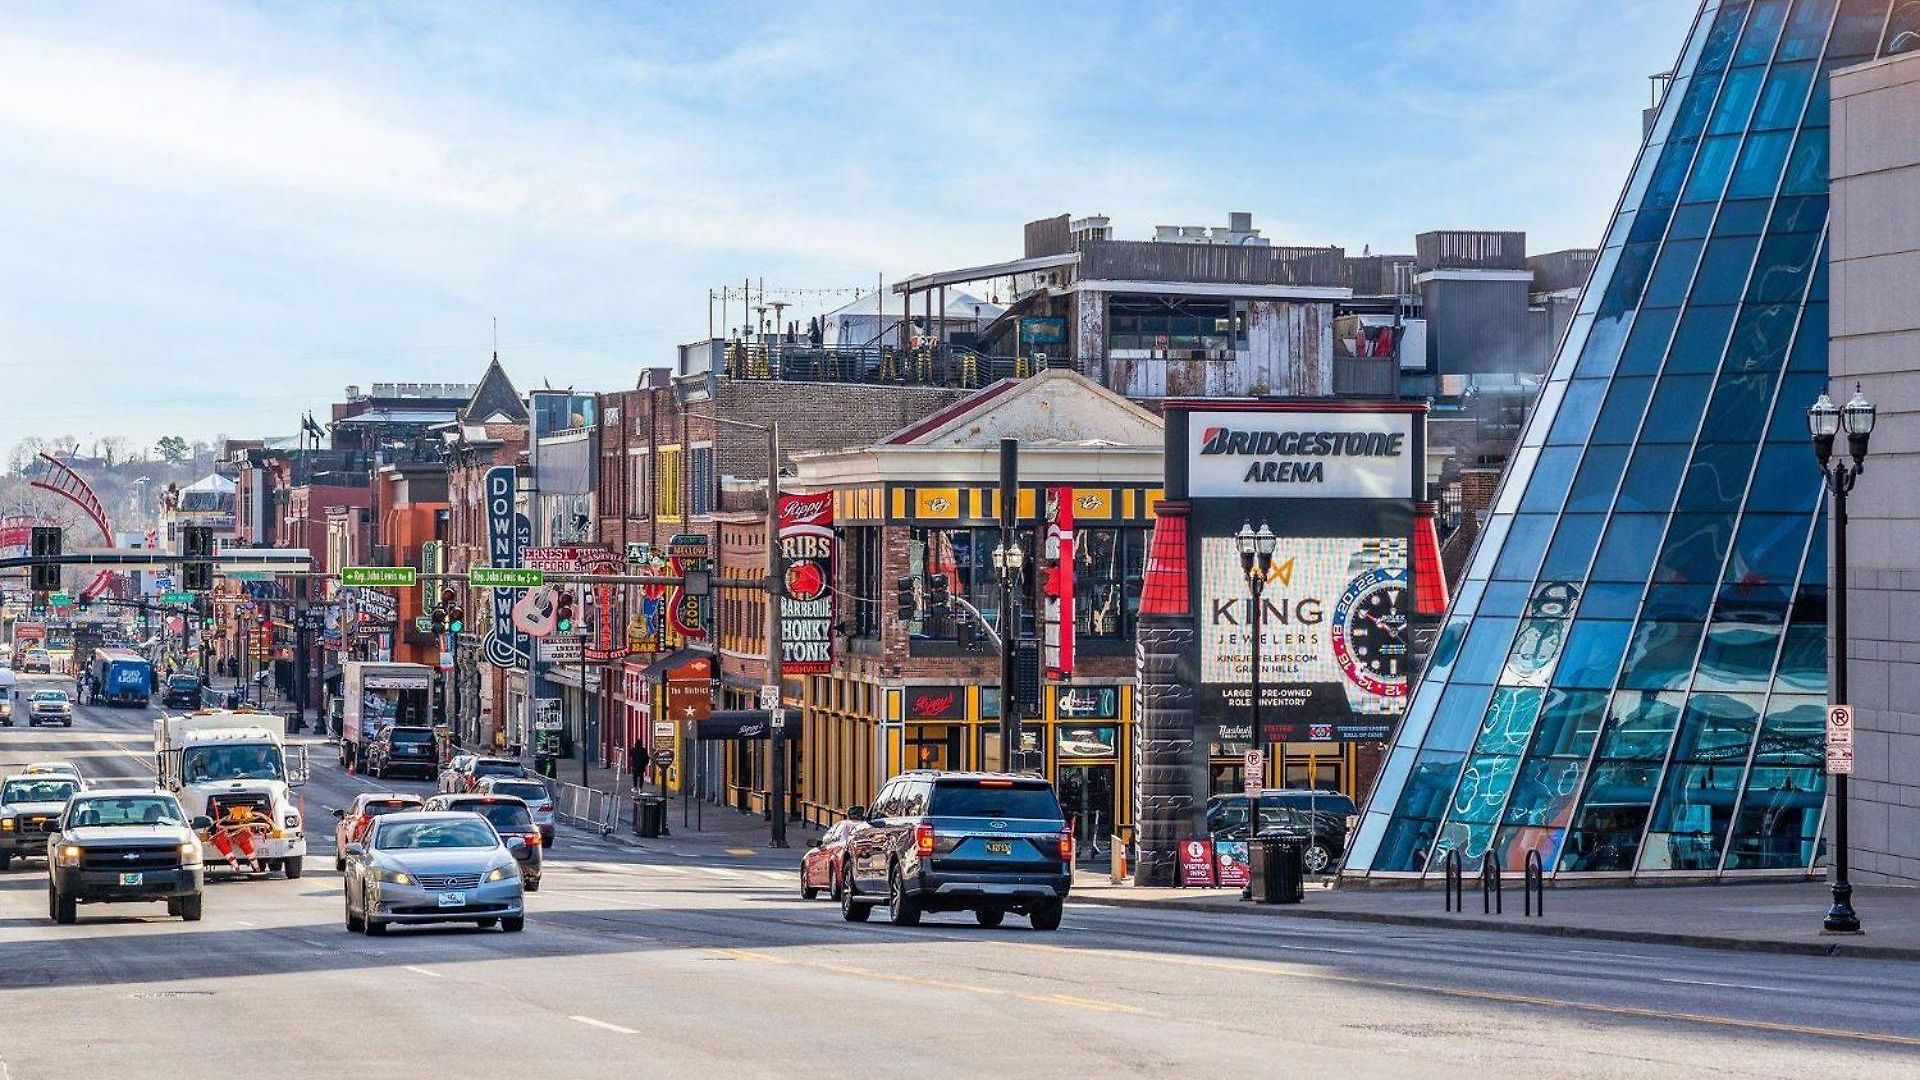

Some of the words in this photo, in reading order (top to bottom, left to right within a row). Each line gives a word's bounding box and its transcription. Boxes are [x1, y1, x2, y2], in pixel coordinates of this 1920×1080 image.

[1200, 426, 1405, 456] BRIDGESTONE
[1243, 461, 1324, 483] ARENA
[781, 536, 831, 559] RIBS
[525, 549, 570, 560] ERNEST
[531, 561, 571, 571] RECORD
[367, 571, 380, 581] John
[382, 571, 398, 581] Lewis
[487, 572, 499, 582] John
[500, 572, 516, 582] Lewis
[1355, 573, 1377, 590] 22
[780, 598, 832, 617] BARBEQUE
[1337, 592, 1353, 612] 20
[1212, 598, 1323, 626] KING
[782, 619, 831, 641] HONKY
[1333, 624, 1342, 642] 18
[1217, 634, 1319, 645] JEWELERS
[782, 642, 831, 662] TONK
[1217, 654, 1318, 663] KINGJEELERS.COM
[782, 665, 830, 674] NASHVILLE
[1236, 665, 1268, 674] GRN
[1271, 665, 1299, 674] HILLS
[118, 676, 143, 684] LIGHT
[1261, 690, 1312, 698] PRE-OWNED
[1228, 699, 1253, 707] ROLE
[1258, 699, 1307, 707] INVENTORY
